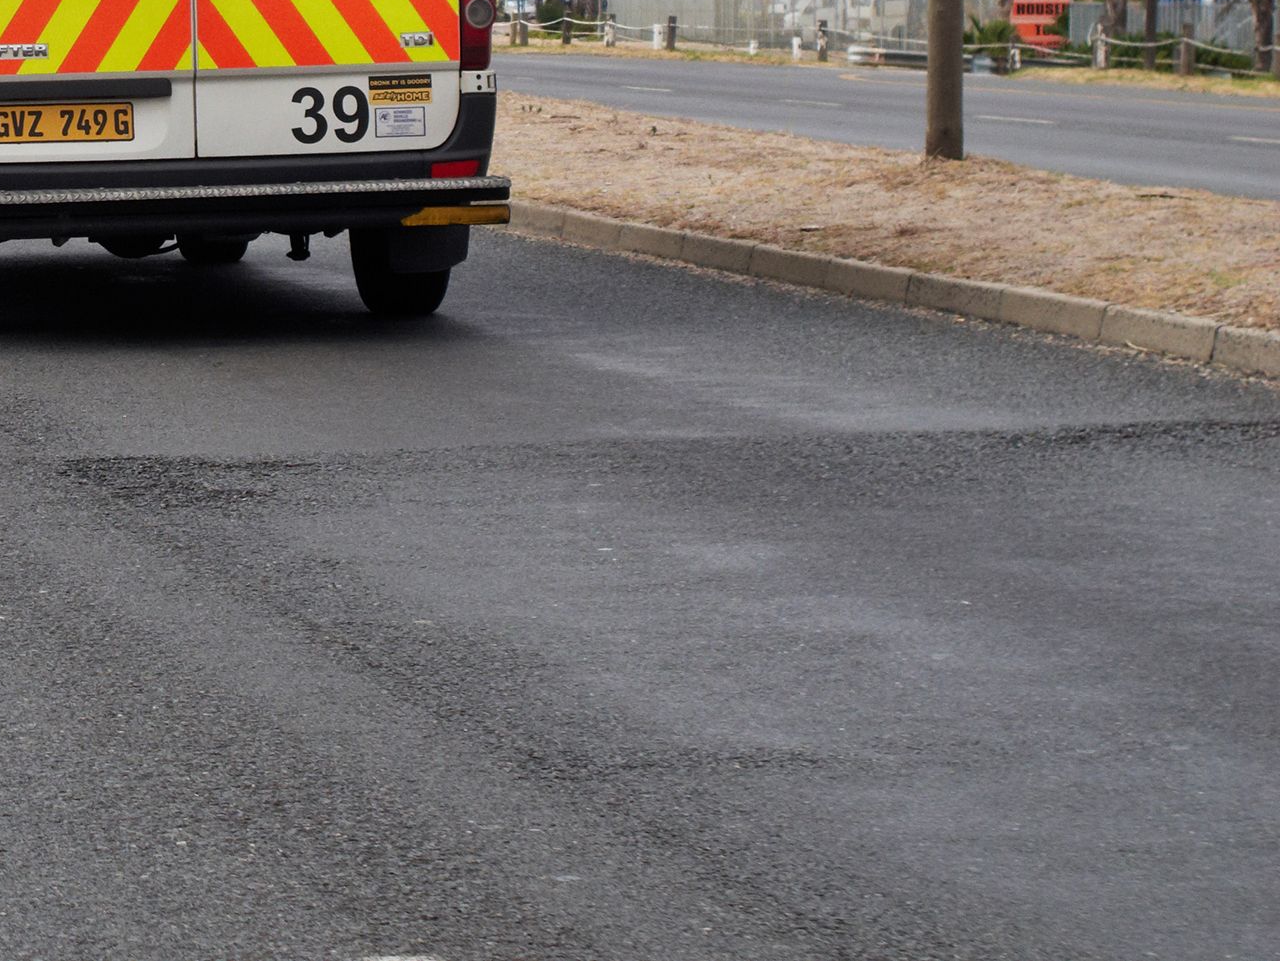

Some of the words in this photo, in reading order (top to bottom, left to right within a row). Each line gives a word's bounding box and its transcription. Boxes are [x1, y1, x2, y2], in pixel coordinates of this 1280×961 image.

[402, 33, 433, 47] TDI
[60, 109, 107, 136] 749
[114, 109, 129, 135] G
[291, 86, 370, 144] 39
